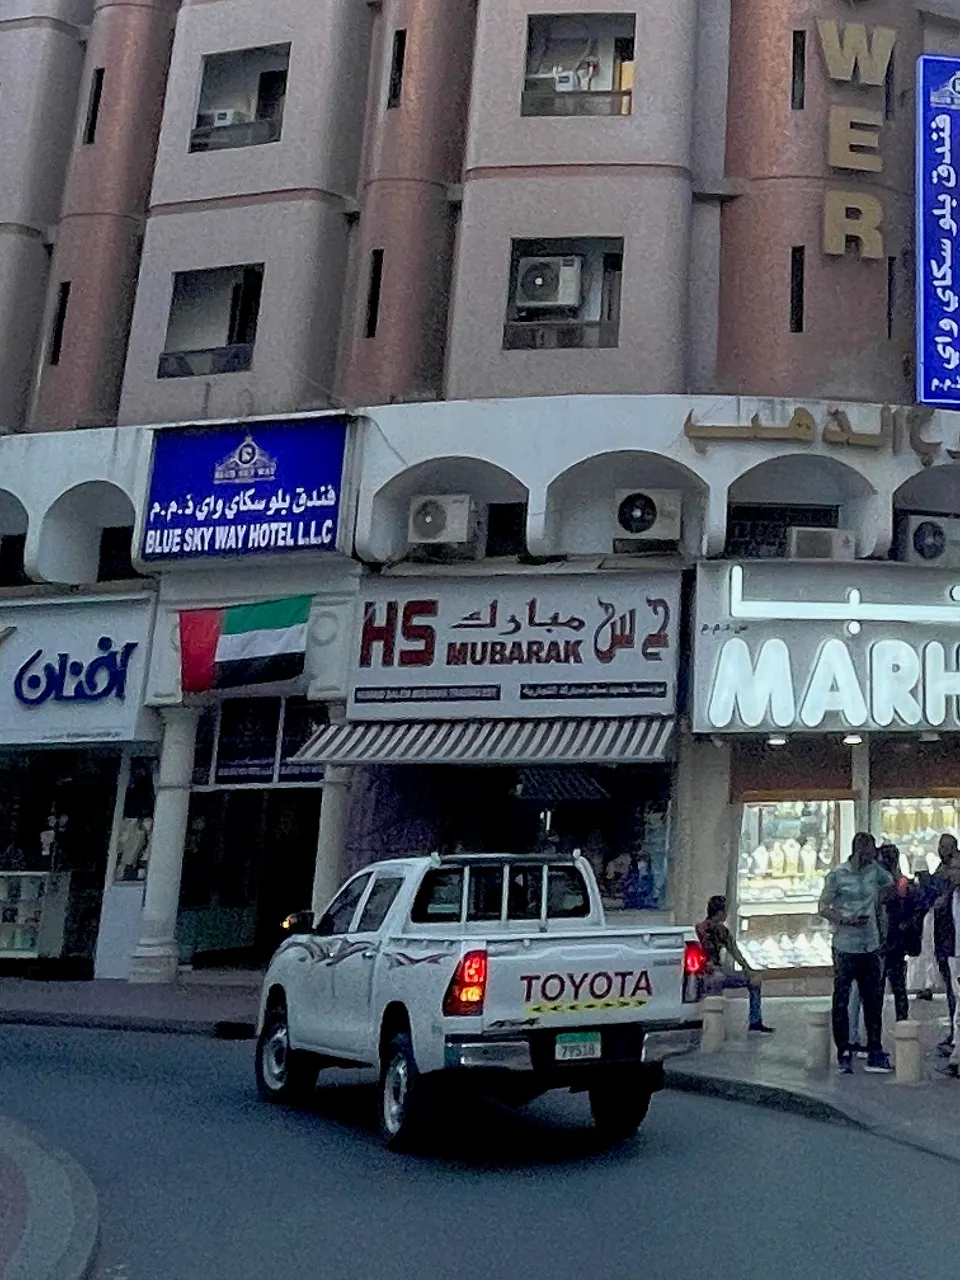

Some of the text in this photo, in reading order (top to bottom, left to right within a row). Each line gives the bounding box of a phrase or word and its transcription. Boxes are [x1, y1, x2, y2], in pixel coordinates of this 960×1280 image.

[930, 114, 957, 188] فندق
[931, 193, 957, 237] بلو
[930, 237, 959, 313] سكاي
[935, 317, 960, 370] واي
[195, 494, 223, 521] واي
[224, 488, 266, 519] سكاي
[266, 487, 291, 515] بلو
[292, 484, 337, 514] فندق
[145, 527, 182, 554] BLUE
[183, 526, 214, 552] SKY
[214, 523, 248, 550] WAY
[247, 521, 294, 549] HOTEL
[451, 597, 586, 636] مبارك
[359, 599, 439, 668] HS
[445, 639, 584, 666] MUBARAK
[520, 970, 653, 1002] TOYOTA
